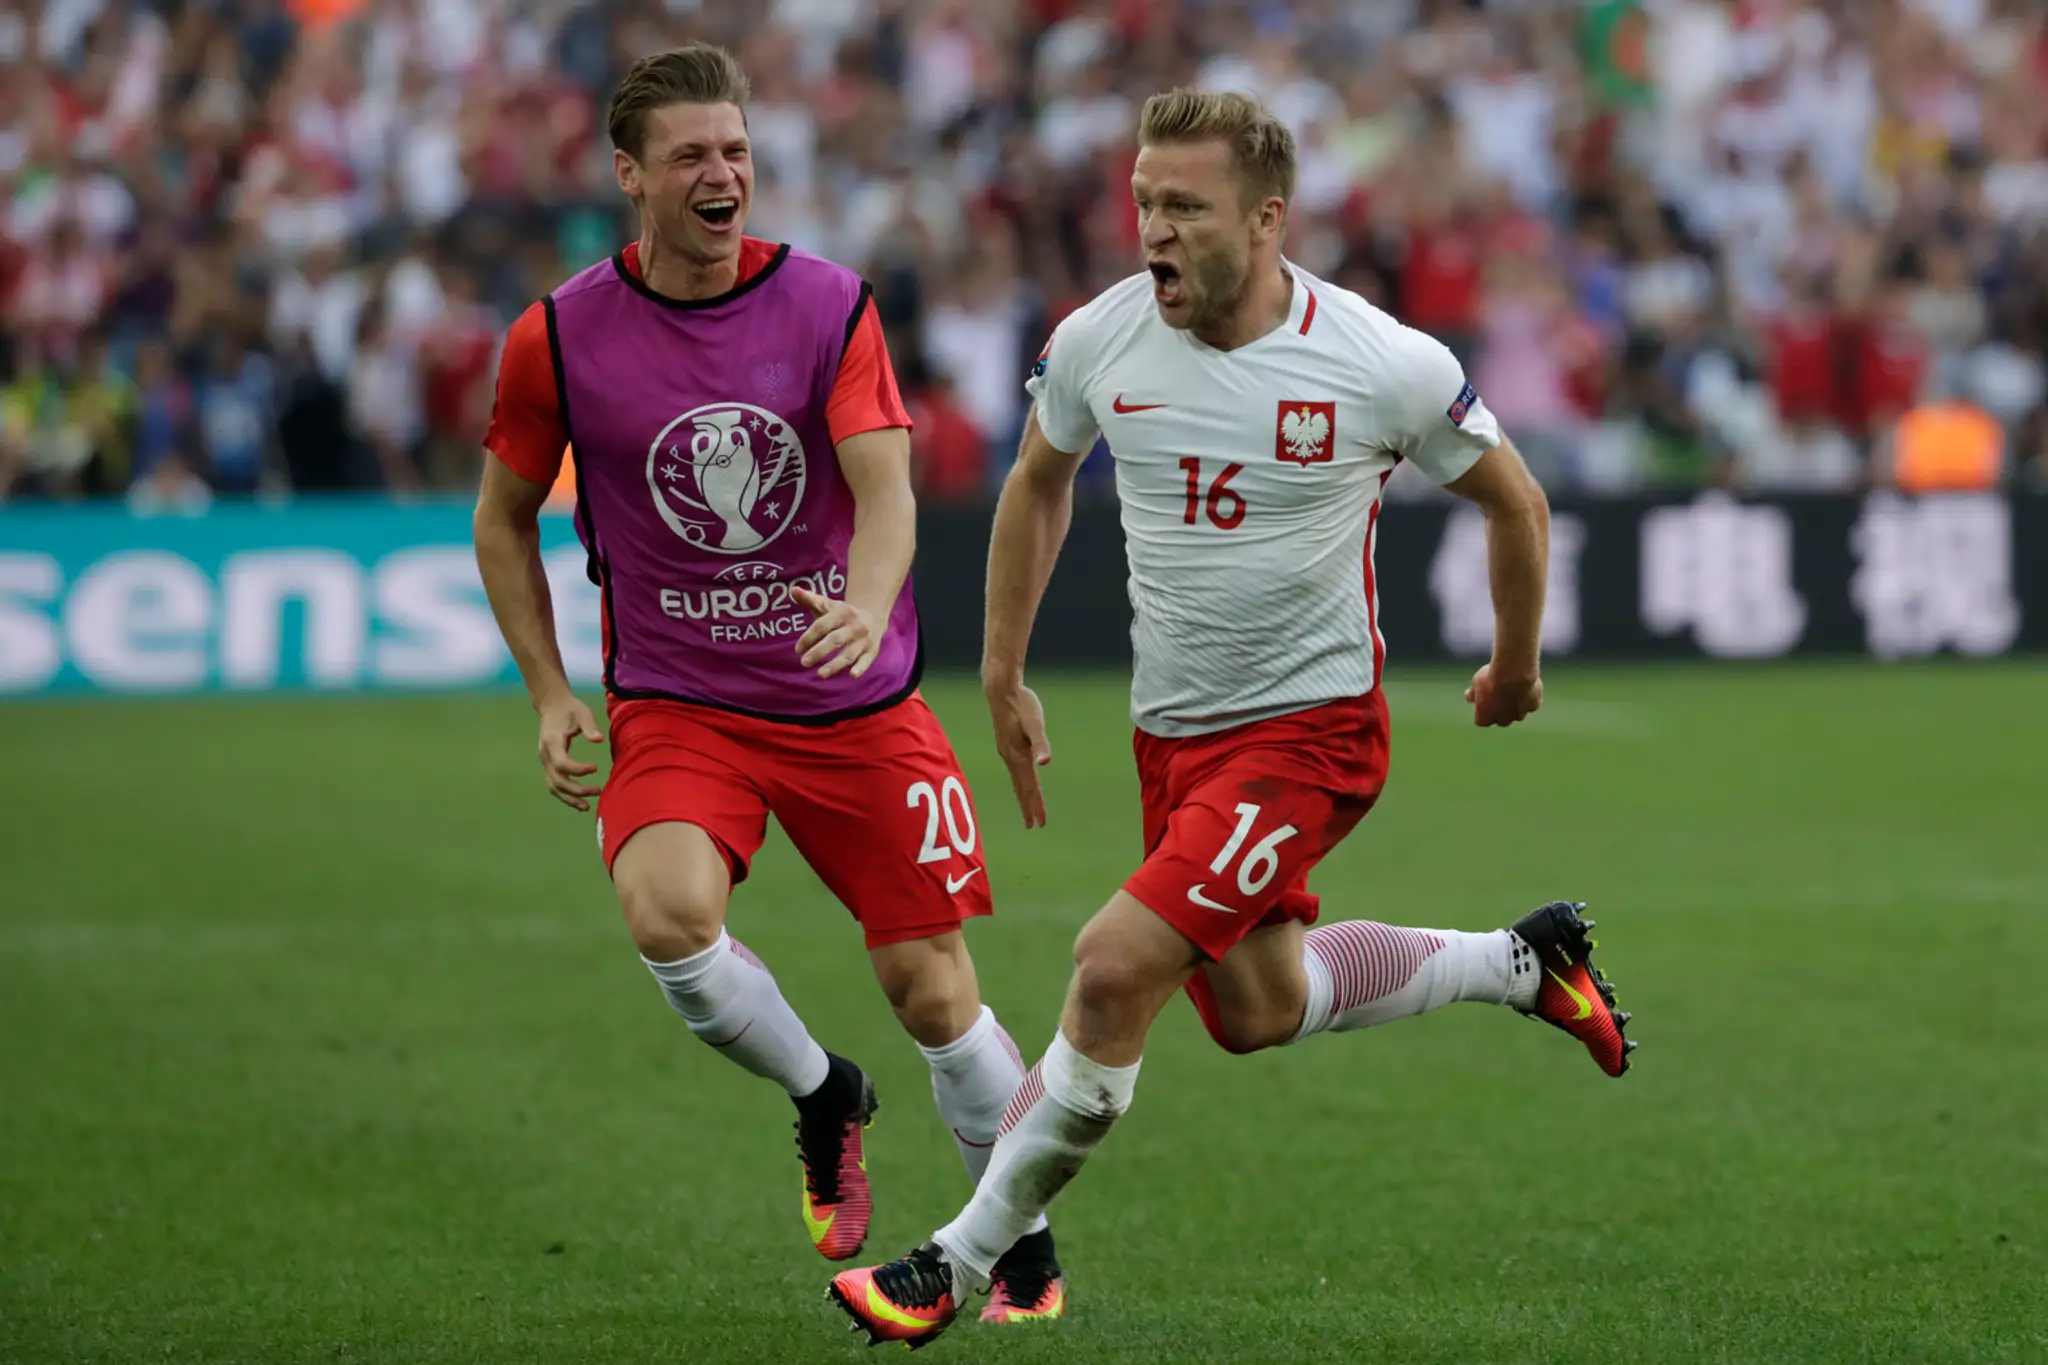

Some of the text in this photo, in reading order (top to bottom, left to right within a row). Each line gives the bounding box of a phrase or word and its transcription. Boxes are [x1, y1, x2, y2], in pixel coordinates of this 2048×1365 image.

[1178, 457, 1247, 530] 16
[716, 565, 778, 583] EFA
[711, 613, 808, 643] FRANCE
[907, 776, 976, 864] 20
[1209, 802, 1299, 896] 16
